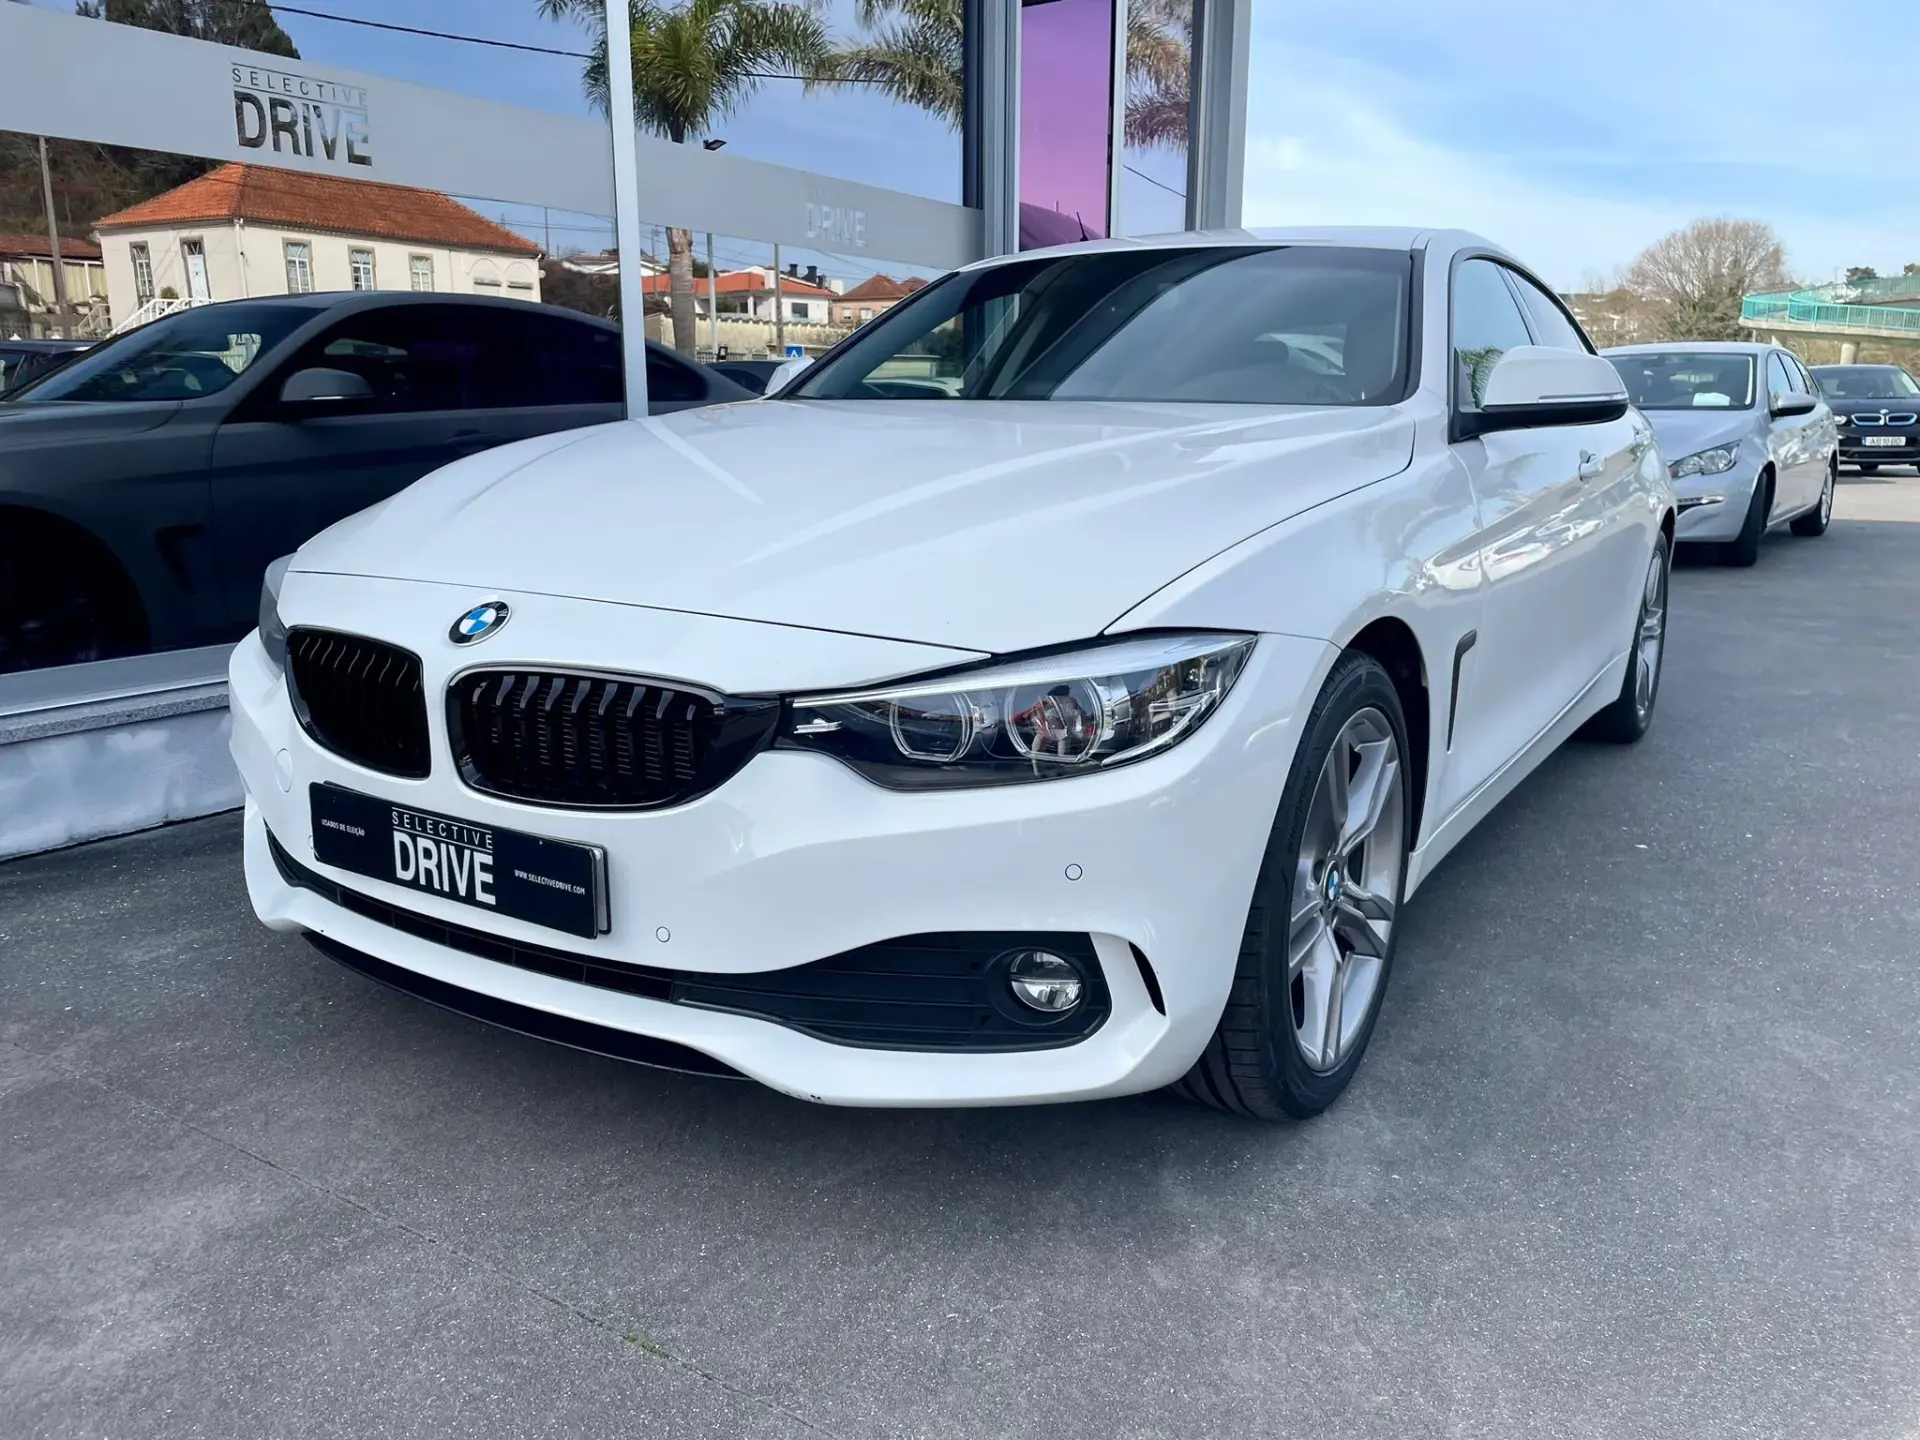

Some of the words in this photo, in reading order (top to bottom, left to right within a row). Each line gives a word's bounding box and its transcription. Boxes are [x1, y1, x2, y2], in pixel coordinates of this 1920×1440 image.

[232, 68, 368, 104] SELECTIVE
[234, 90, 373, 167] DRIVE
[339, 823, 346, 831] DE
[392, 811, 493, 849] SELECTIVE
[393, 831, 496, 905] DRIVE
